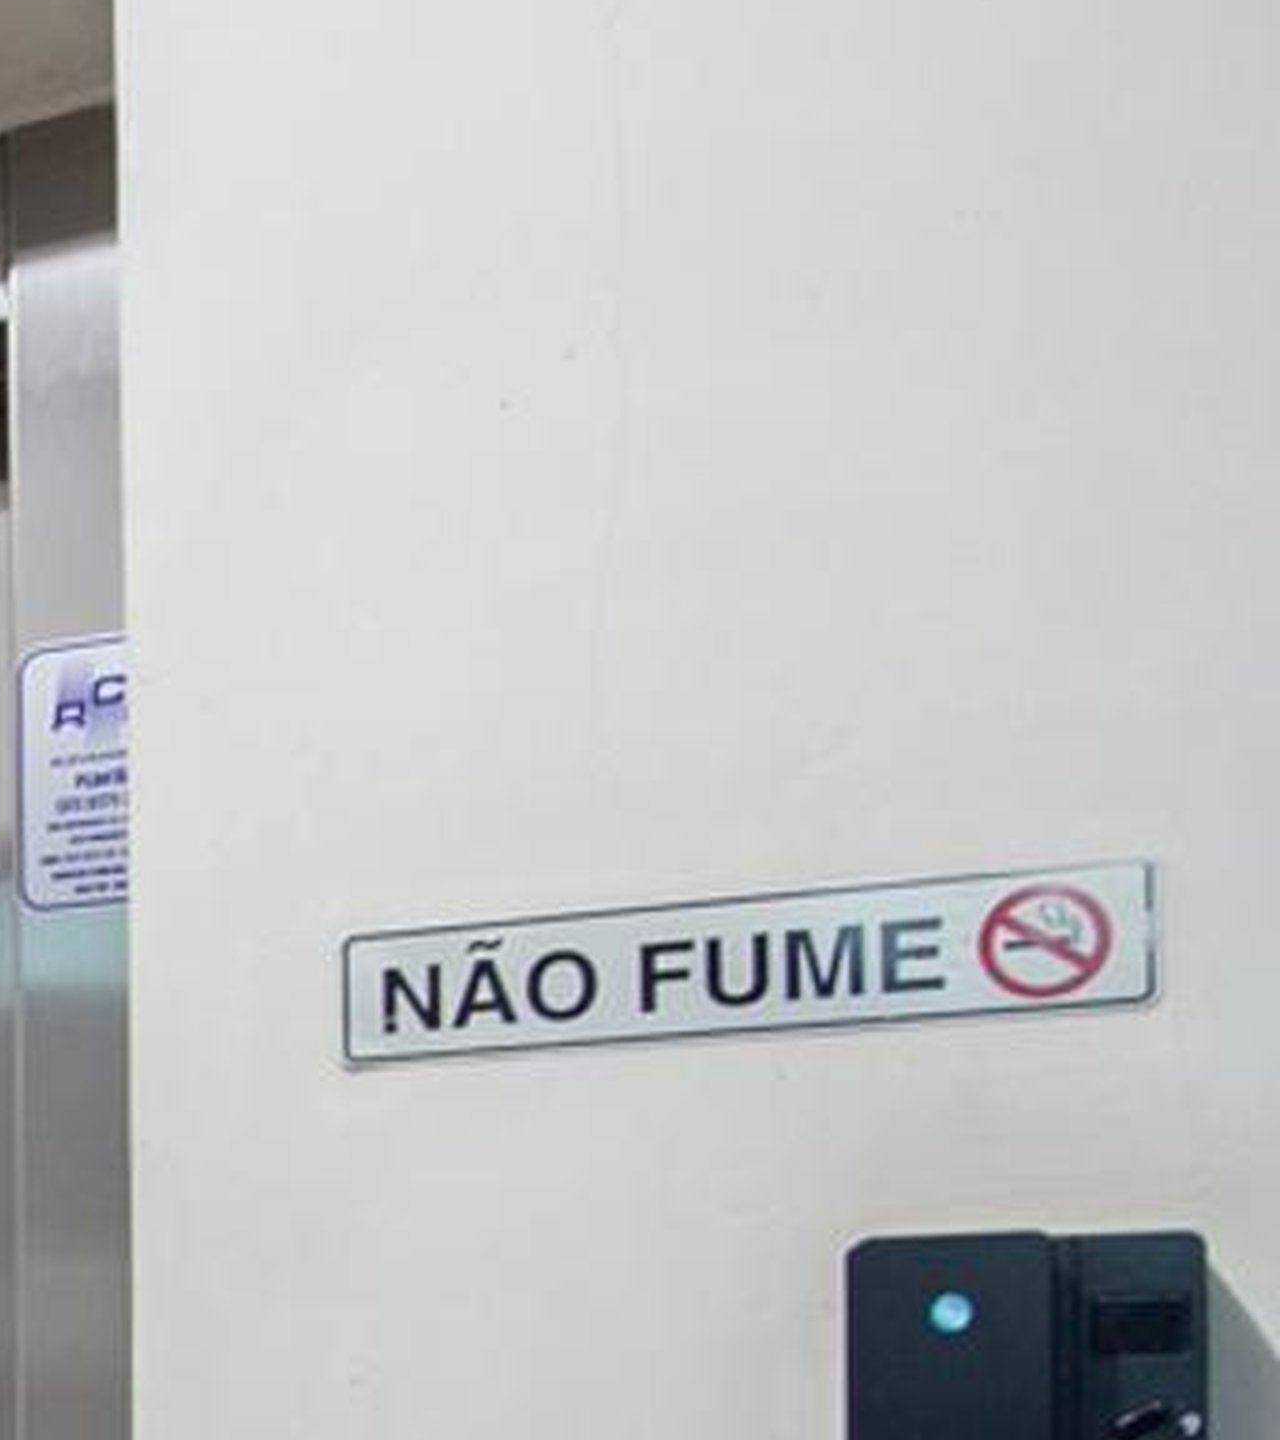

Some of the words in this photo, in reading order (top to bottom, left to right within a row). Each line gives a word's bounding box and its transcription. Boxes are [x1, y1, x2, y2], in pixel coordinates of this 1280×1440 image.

[380, 938, 598, 1035] NÃO
[638, 916, 946, 1014] FUME
[1178, 1412, 1201, 1436] 9
